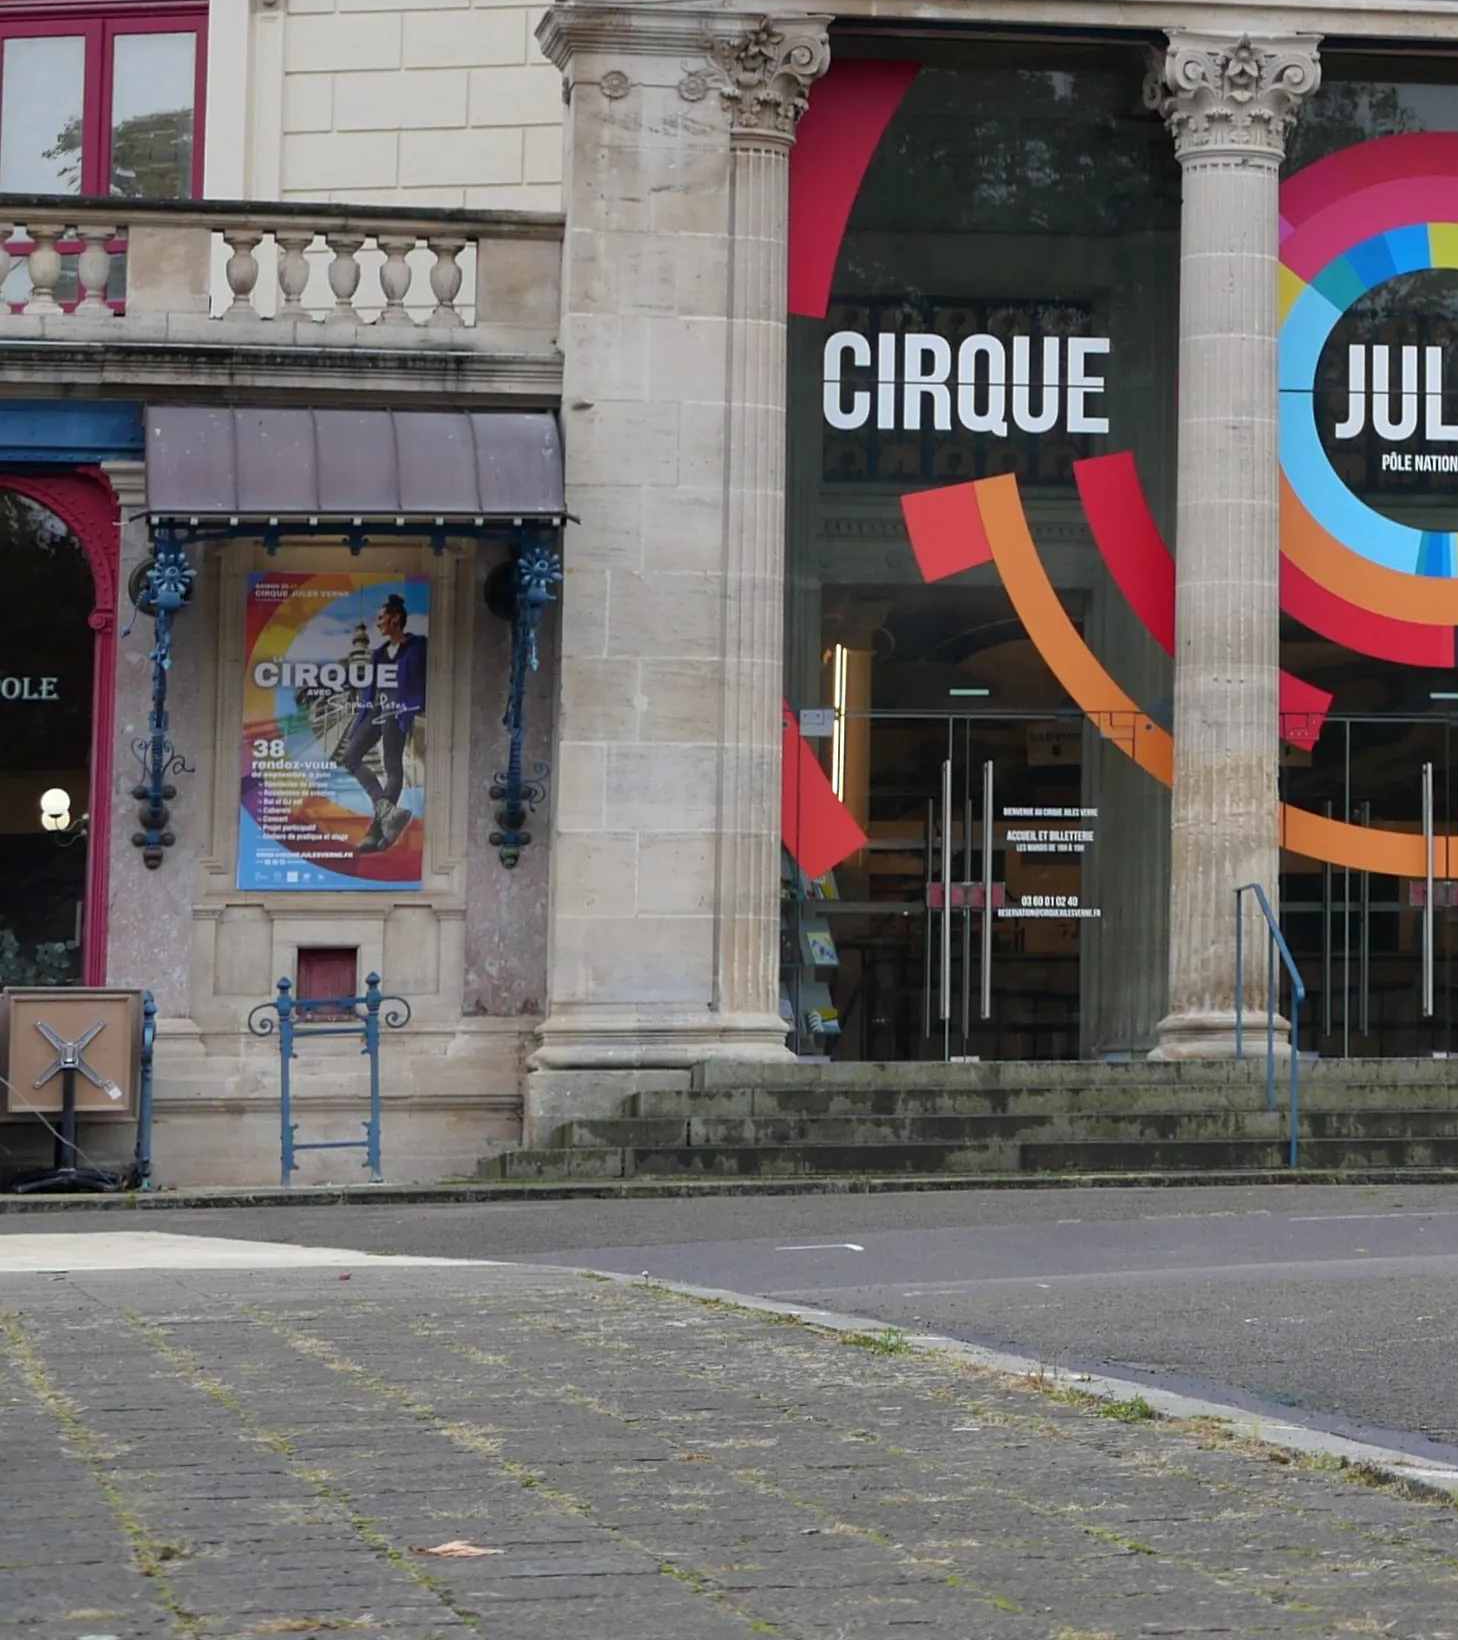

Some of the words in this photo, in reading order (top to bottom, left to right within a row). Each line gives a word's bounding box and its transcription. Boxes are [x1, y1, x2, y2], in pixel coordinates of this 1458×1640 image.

[823, 331, 1110, 437] CIRQUE
[1381, 451, 1412, 471] PÔLE
[255, 590, 288, 598] CIRQUE
[254, 662, 399, 692] CIRQUE
[252, 739, 285, 758] 38
[252, 759, 338, 770] rendez-vous
[1006, 830, 1037, 841] ACCUEIL
[1038, 830, 1048, 841] ET
[1049, 830, 1095, 842] BILLETTERIE
[1021, 895, 1032, 907] 03
[1044, 895, 1054, 907] 01
[1056, 895, 1067, 907] 02
[1067, 895, 1079, 907] 40
